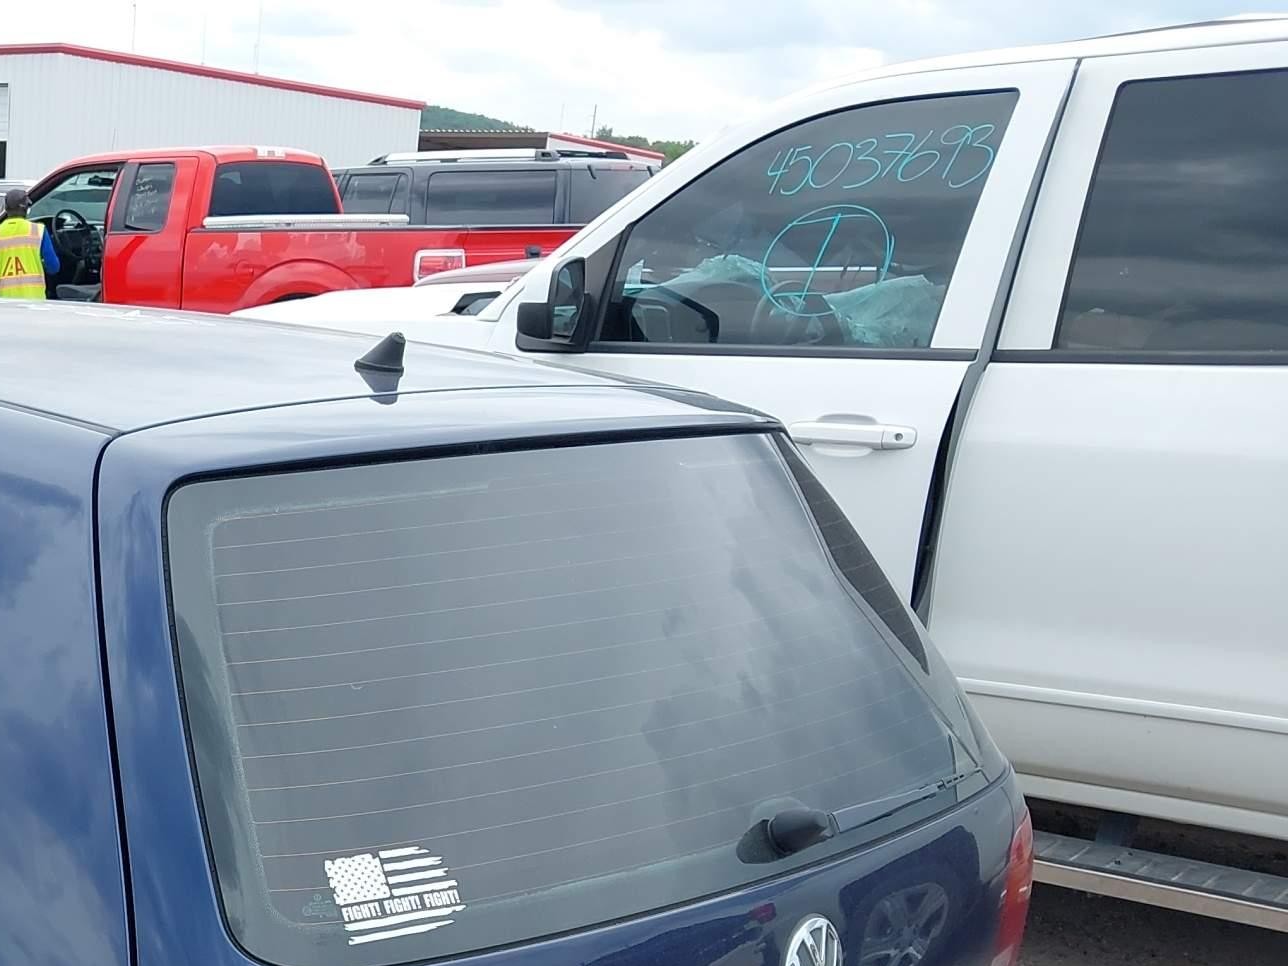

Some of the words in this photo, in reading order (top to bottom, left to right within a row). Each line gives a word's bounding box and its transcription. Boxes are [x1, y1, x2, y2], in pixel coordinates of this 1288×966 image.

[767, 123, 996, 195] 45037693
[341, 901, 382, 922] FIGHT!
[383, 895, 422, 915] FIGHT!
[423, 889, 461, 908] FIGHT!
